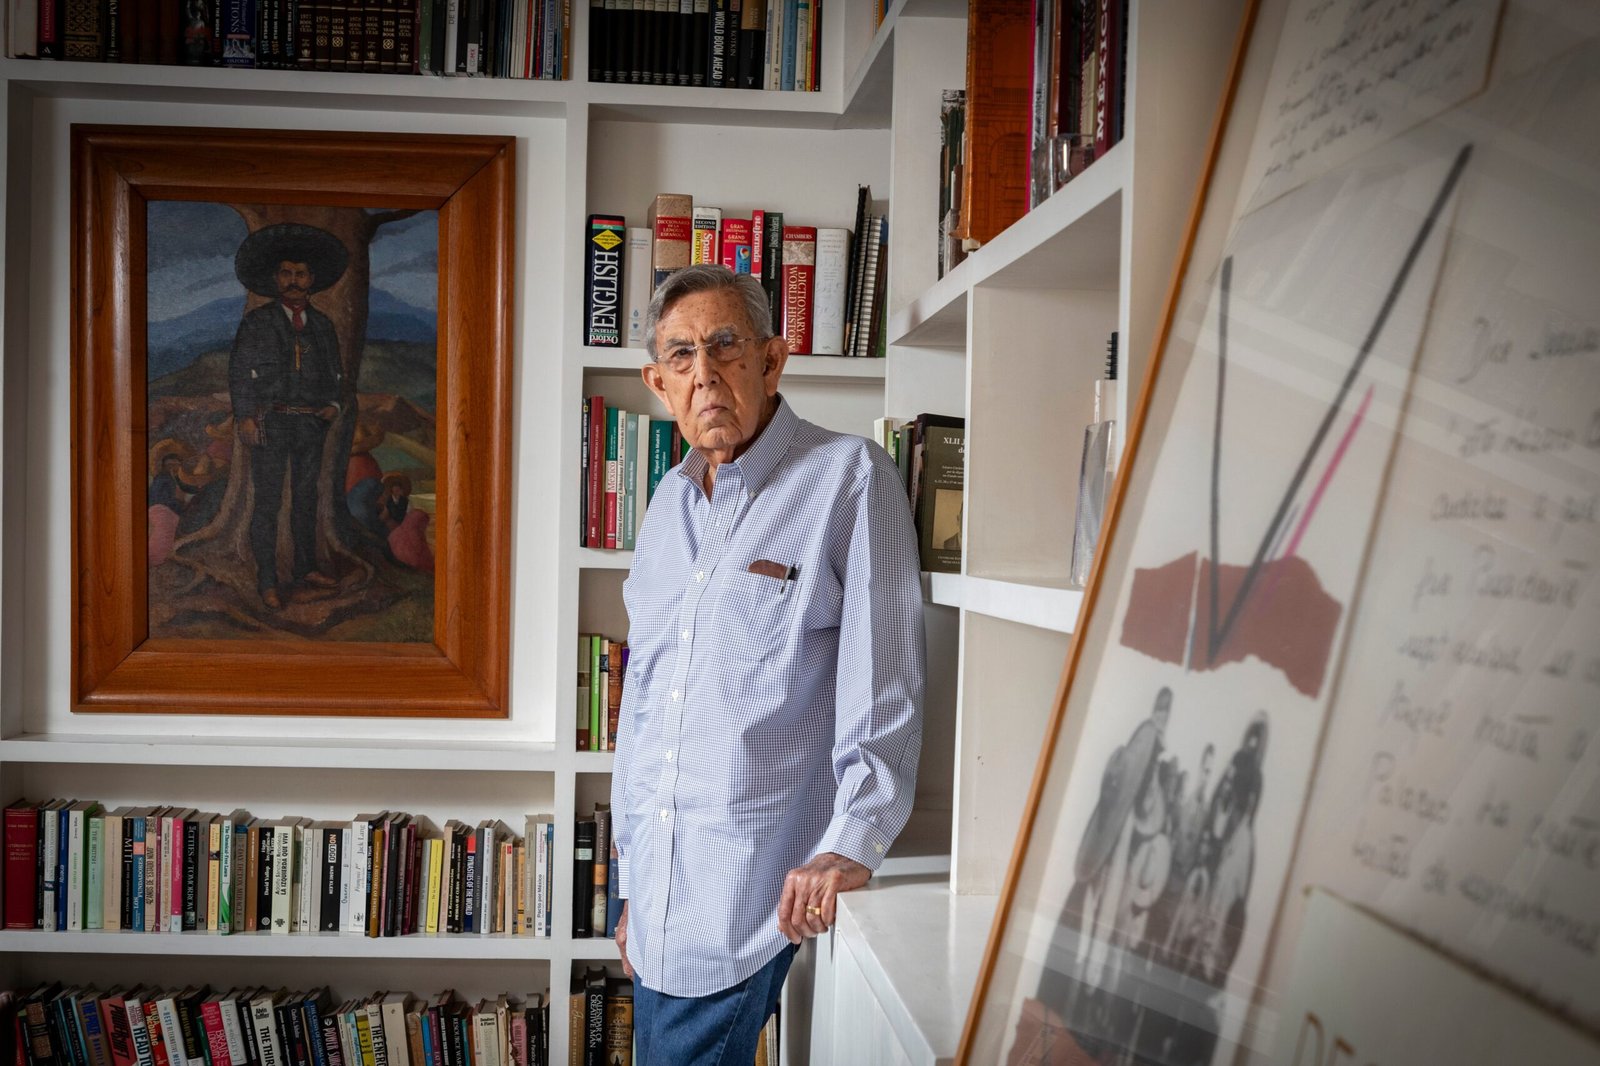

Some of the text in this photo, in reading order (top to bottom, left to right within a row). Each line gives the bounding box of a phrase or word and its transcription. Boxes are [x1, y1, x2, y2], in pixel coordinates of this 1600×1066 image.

[448, 14, 455, 25] DE
[711, 11, 726, 80] WORLD BOOM AHEAD
[729, 30, 738, 57] KOTKIN
[592, 250, 619, 329] ENGLISH
[786, 266, 798, 352] WORLD HISTORY
[795, 271, 807, 346] DICTIONARY OF
[589, 335, 619, 345] Oxford
[654, 434, 662, 448] Madrid
[943, 437, 960, 448] XLII
[605, 462, 617, 491] México
[654, 460, 662, 474] Miguel
[124, 837, 133, 864] MITI
[186, 830, 195, 856] CITIES
[329, 833, 337, 844] NO
[356, 824, 366, 855] Jack Lang
[58, 864, 66, 884] energy
[466, 855, 475, 881] DYNASTIES
[186, 865, 195, 912] TOMORROW
[235, 863, 244, 917] DETOX MIRACLE
[465, 888, 473, 897] THE
[465, 897, 473, 916] WORLD
[134, 1006, 144, 1023] LESTER
[150, 1003, 160, 1026] LINDA
[163, 1012, 173, 1026] BEST
[311, 1015, 320, 1031] CRISIS
[595, 993, 604, 1043] CALENDAR OF
[133, 1027, 150, 1055] HEAD
[146, 1014, 159, 1047] McQUAIG
[229, 1028, 239, 1057] SOCIETY
[259, 1026, 272, 1045] THE
[322, 1028, 338, 1051] POWER
[371, 1024, 383, 1041] THE
[452, 1017, 462, 1051] RESOURCE
[589, 1029, 597, 1048] MAN
[206, 1031, 220, 1060] LONGEVITY
[215, 1029, 229, 1059] BRAIN
[315, 1038, 325, 1058] GLOBAL
